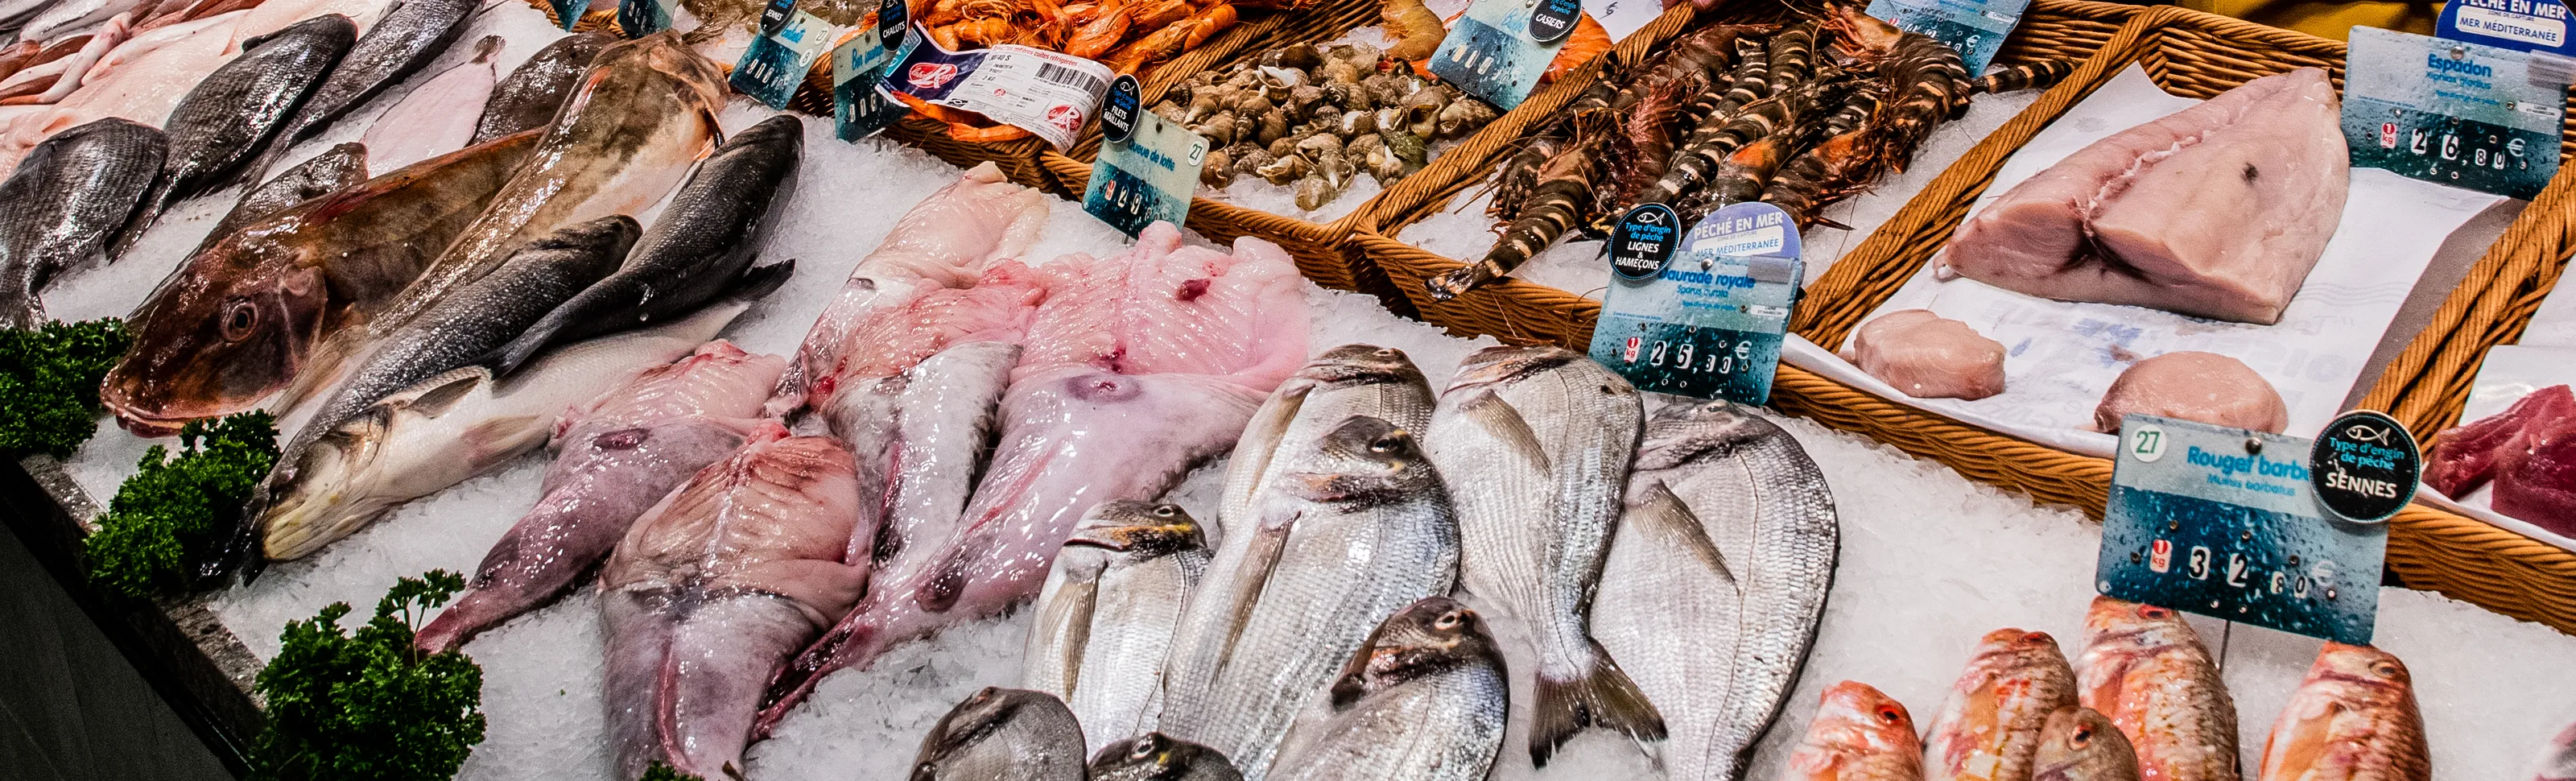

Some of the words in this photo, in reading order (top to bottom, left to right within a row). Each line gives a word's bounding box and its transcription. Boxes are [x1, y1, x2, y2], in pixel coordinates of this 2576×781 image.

[2510, 0, 2531, 14] EN
[2534, 2, 2566, 19] MER
[882, 20, 906, 38] CHALUTS
[1535, 13, 1566, 29] CASIERS
[2459, 17, 2480, 28] MER
[2483, 19, 2557, 42] MÉDITERRANÉE
[2428, 53, 2492, 78] Espadon
[1111, 105, 1128, 120] FILETS
[2382, 134, 2393, 145] kg
[2507, 138, 2526, 157] €
[1128, 138, 1150, 159] Queue
[1150, 149, 1160, 163] de
[1159, 153, 1175, 171] lotte
[1189, 143, 1203, 161] 27
[1626, 222, 1642, 232] Type
[1643, 224, 1671, 236] d'engin
[1694, 217, 1732, 240] PÊCHÉ
[1736, 217, 1752, 232] EN
[1757, 211, 1784, 229] MER
[1630, 231, 1640, 239] de
[1641, 233, 1663, 242] pêche
[1715, 236, 1779, 254] MÉDITERRANÉE
[1627, 241, 1660, 254] LIGNES
[1615, 256, 1660, 271] HAMEÇONS
[1657, 267, 1714, 285] Daurade
[1715, 274, 1757, 290] royale
[1678, 284, 1702, 295] Sparus
[1626, 349, 1636, 357] kg
[1735, 341, 1752, 360] €
[2136, 430, 2161, 454] 27
[2330, 437, 2357, 452] Type
[2359, 442, 2405, 461] d'engin
[2187, 445, 2255, 477] Rouget
[2340, 451, 2356, 464] de
[2357, 455, 2395, 471] pêche
[2326, 471, 2397, 498] SENNES
[2152, 556, 2165, 568] kg
